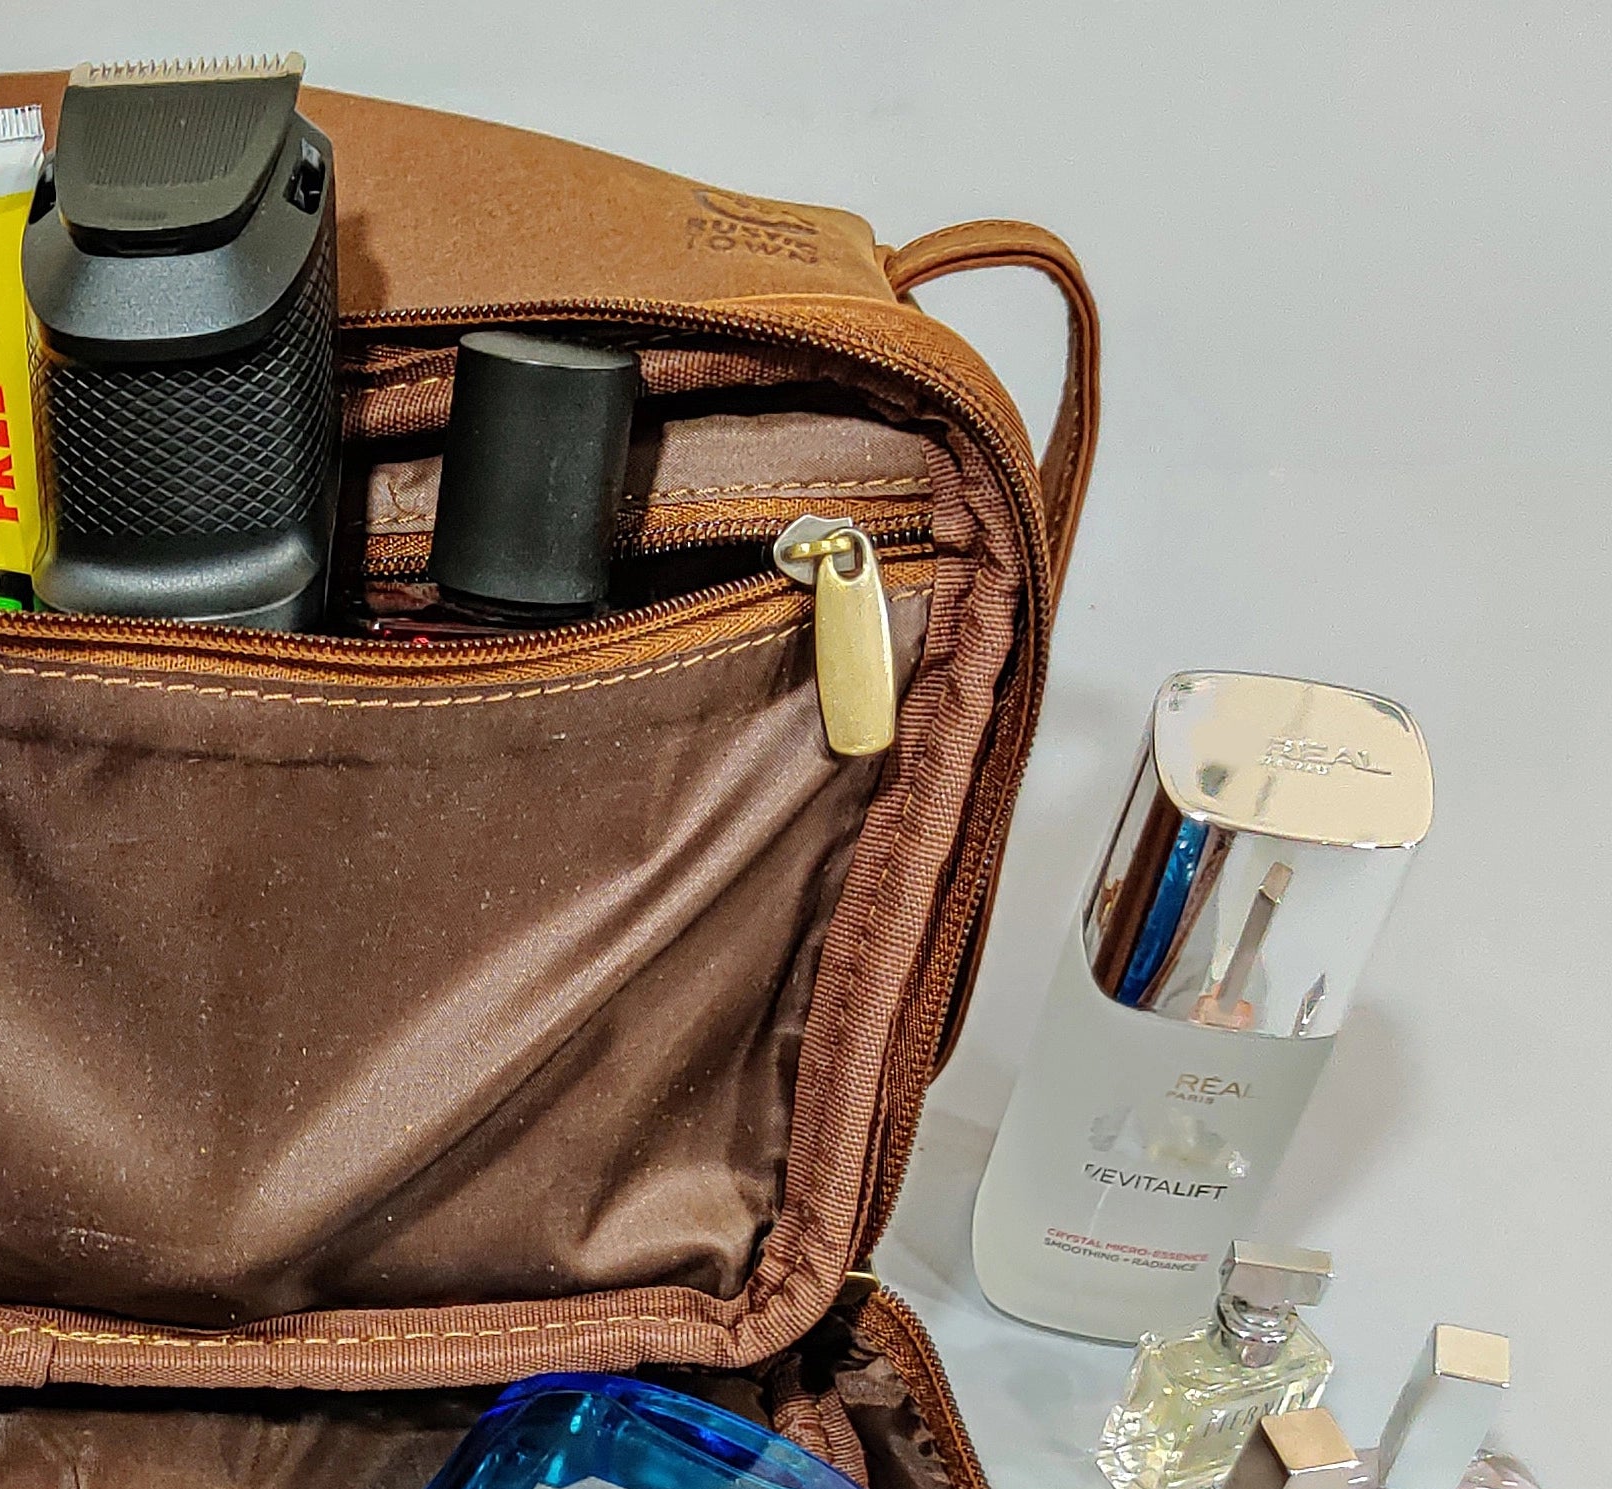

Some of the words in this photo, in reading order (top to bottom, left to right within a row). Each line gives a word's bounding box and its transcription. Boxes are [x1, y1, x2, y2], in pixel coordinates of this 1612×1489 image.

[1046, 1227, 1101, 1249] CRYSTAL
[1043, 1237, 1119, 1263] SMOOTHING
[1131, 1257, 1199, 1272] RADIANCE
